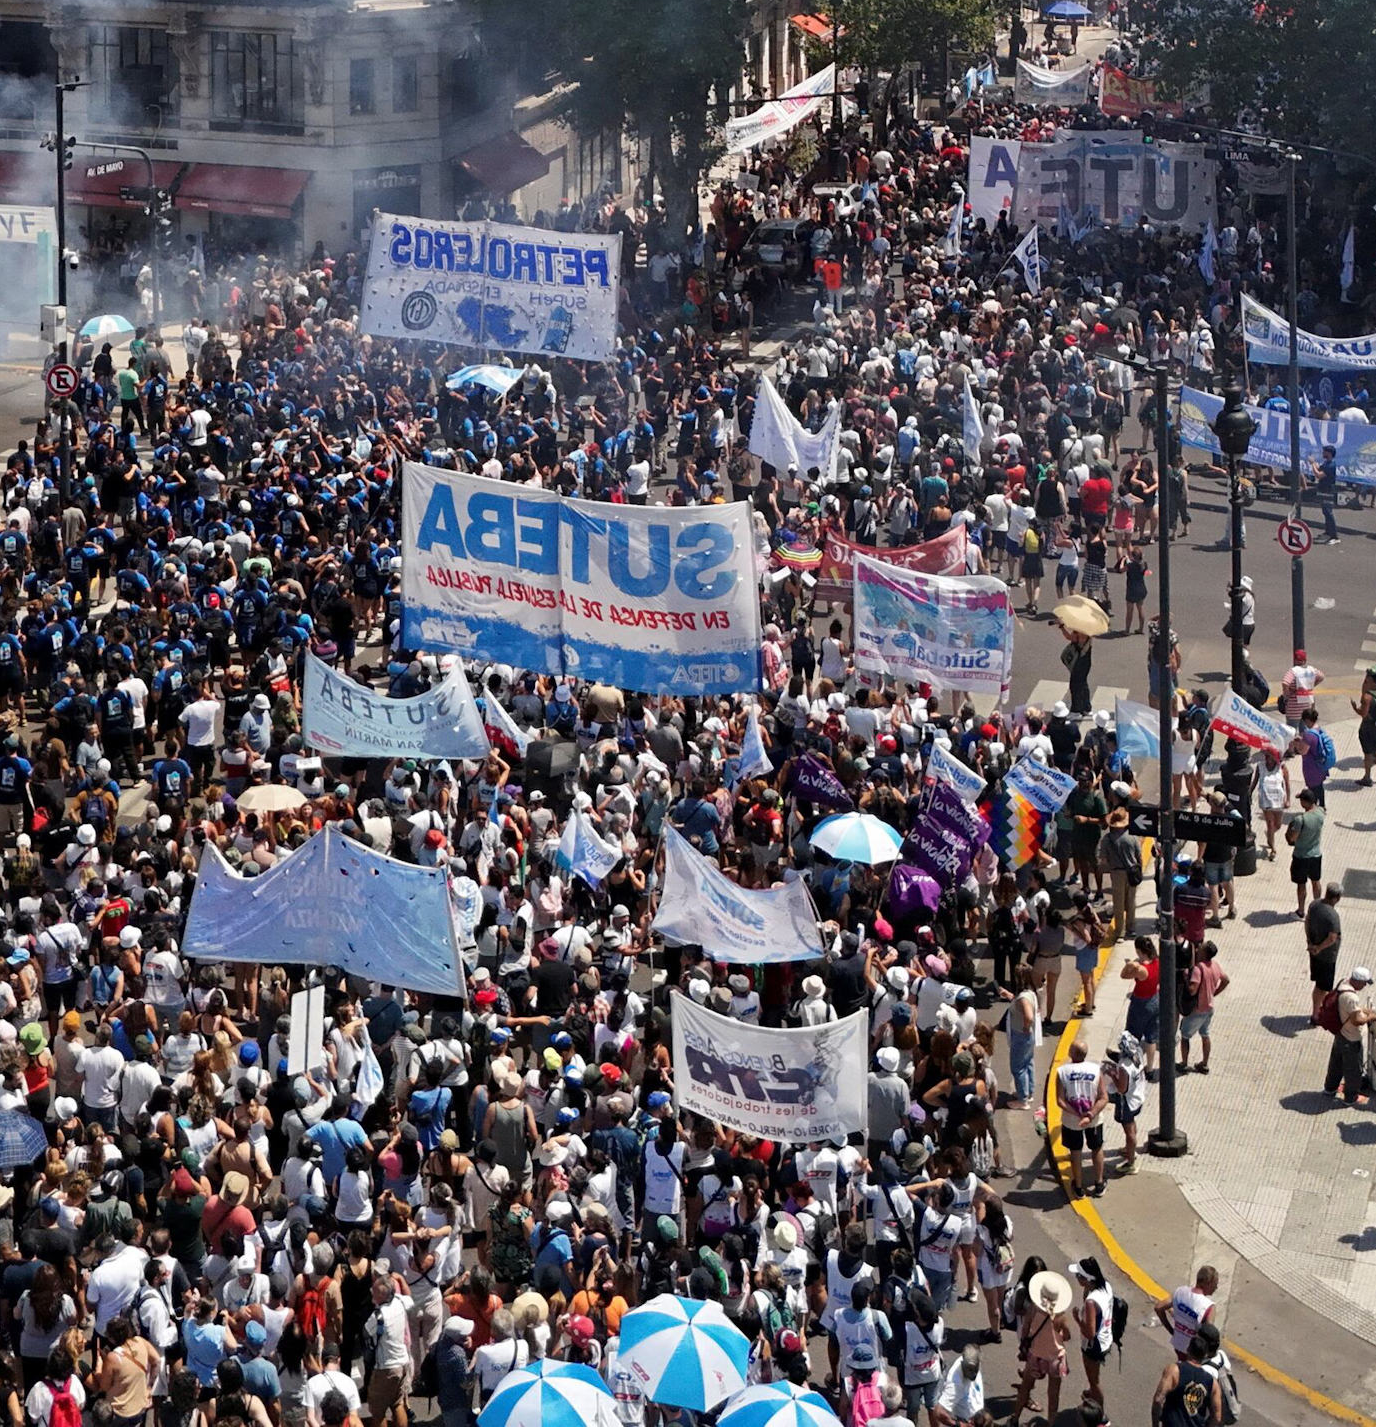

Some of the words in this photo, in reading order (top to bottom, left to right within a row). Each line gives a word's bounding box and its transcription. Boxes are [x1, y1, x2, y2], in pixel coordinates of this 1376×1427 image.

[1224, 150, 1250, 162] LIMA
[106, 160, 124, 173] MAYO
[1178, 812, 1191, 821] Av.
[1201, 815, 1212, 824] de
[1214, 817, 1234, 827] Julio
